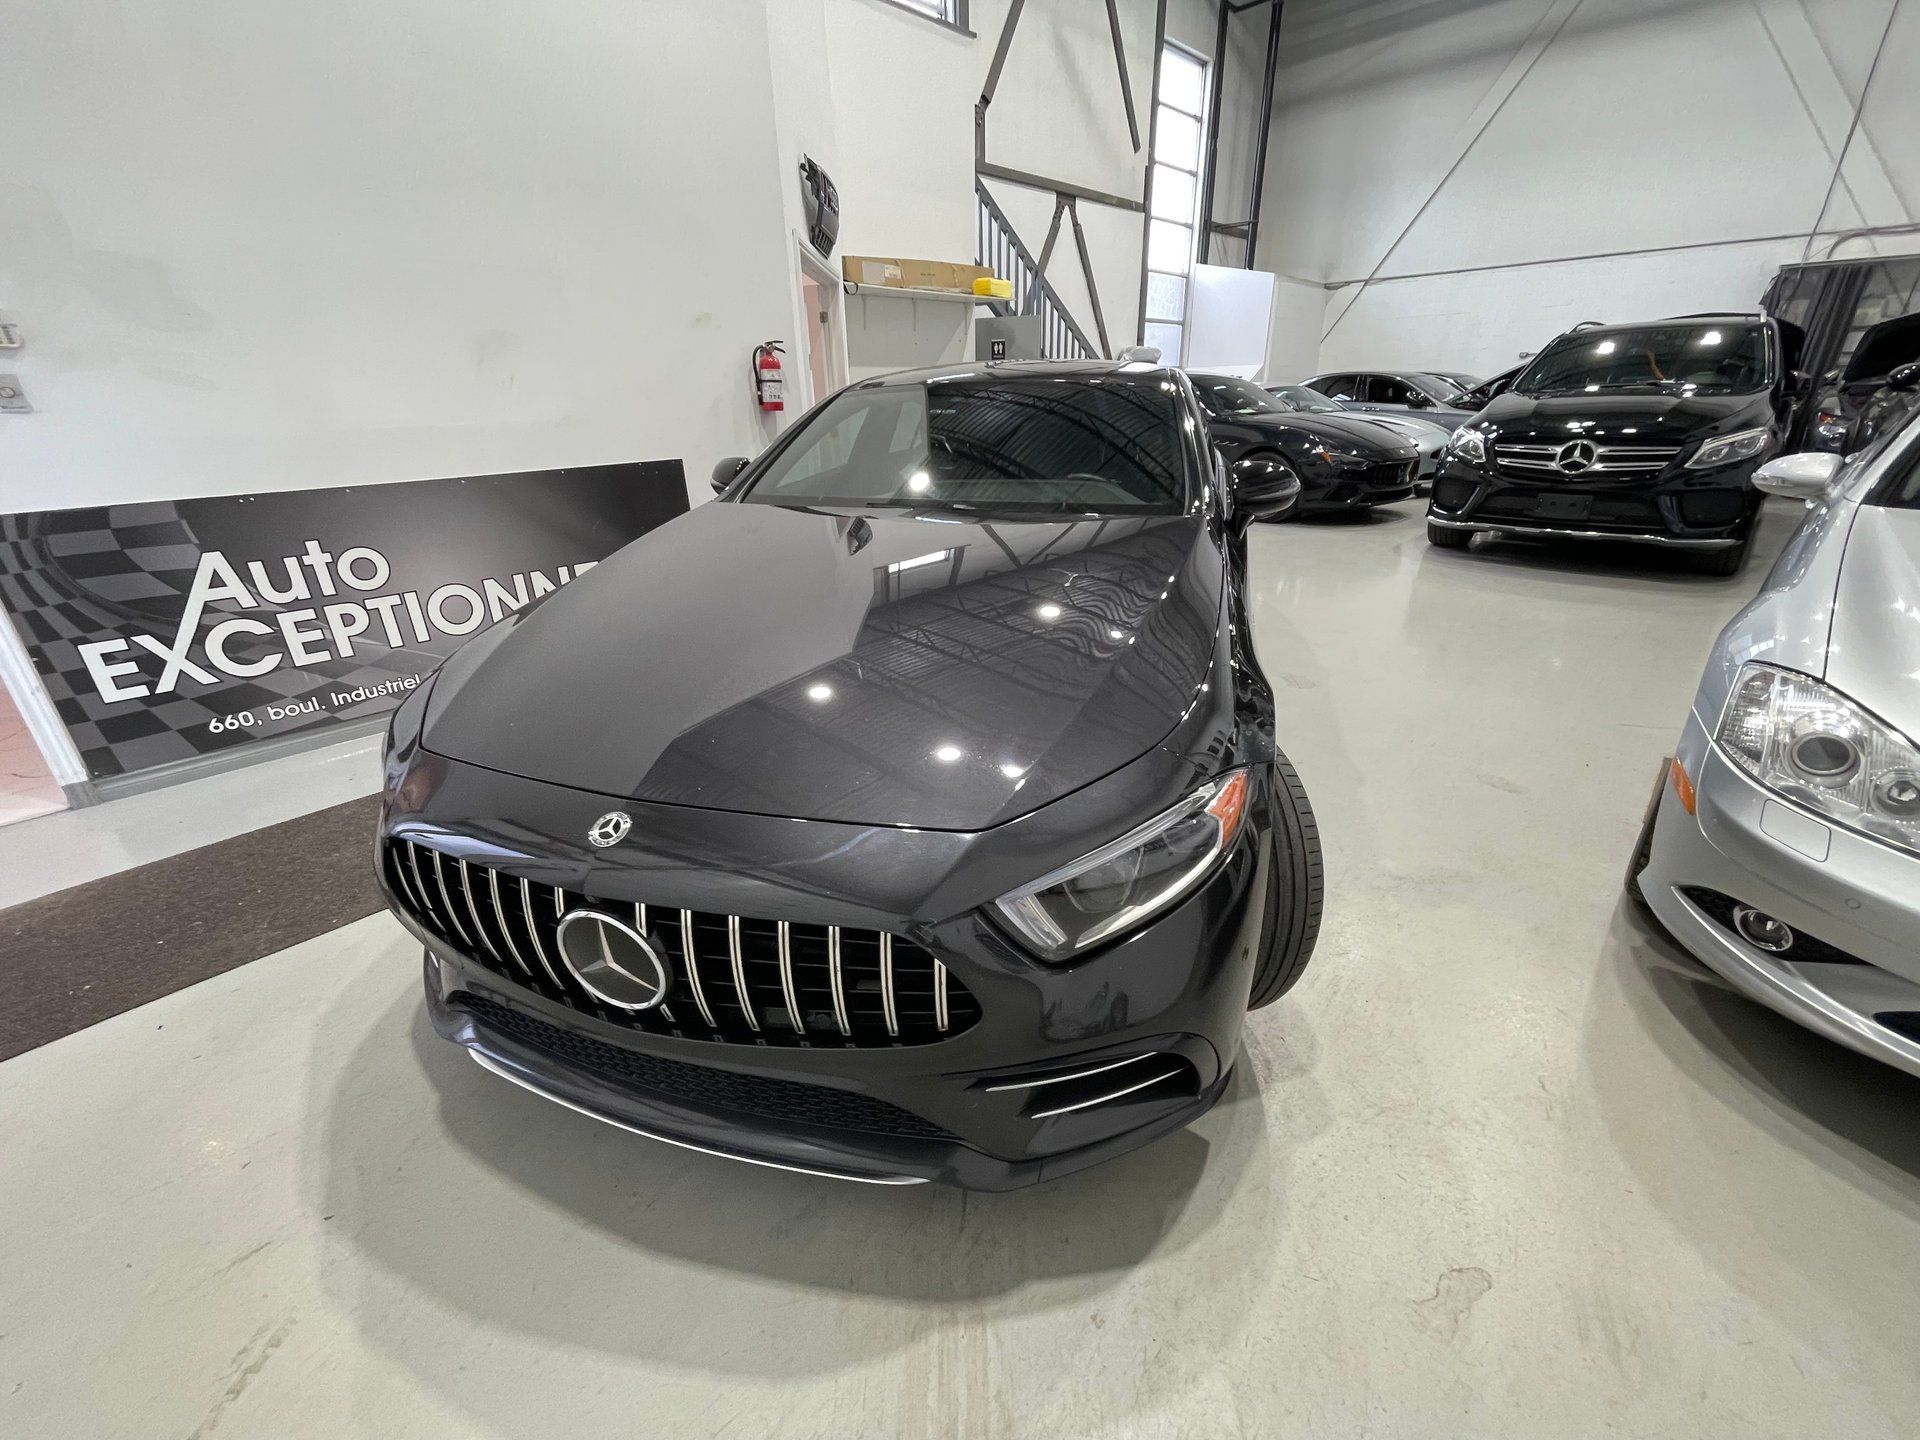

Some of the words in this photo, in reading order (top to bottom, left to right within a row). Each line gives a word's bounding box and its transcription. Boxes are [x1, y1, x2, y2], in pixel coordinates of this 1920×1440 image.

[187, 539, 392, 609] Auto
[77, 560, 600, 705] EXCEPTIONN
[208, 710, 263, 734] 660,
[266, 696, 326, 721] boul.
[330, 673, 421, 707] Industriel
